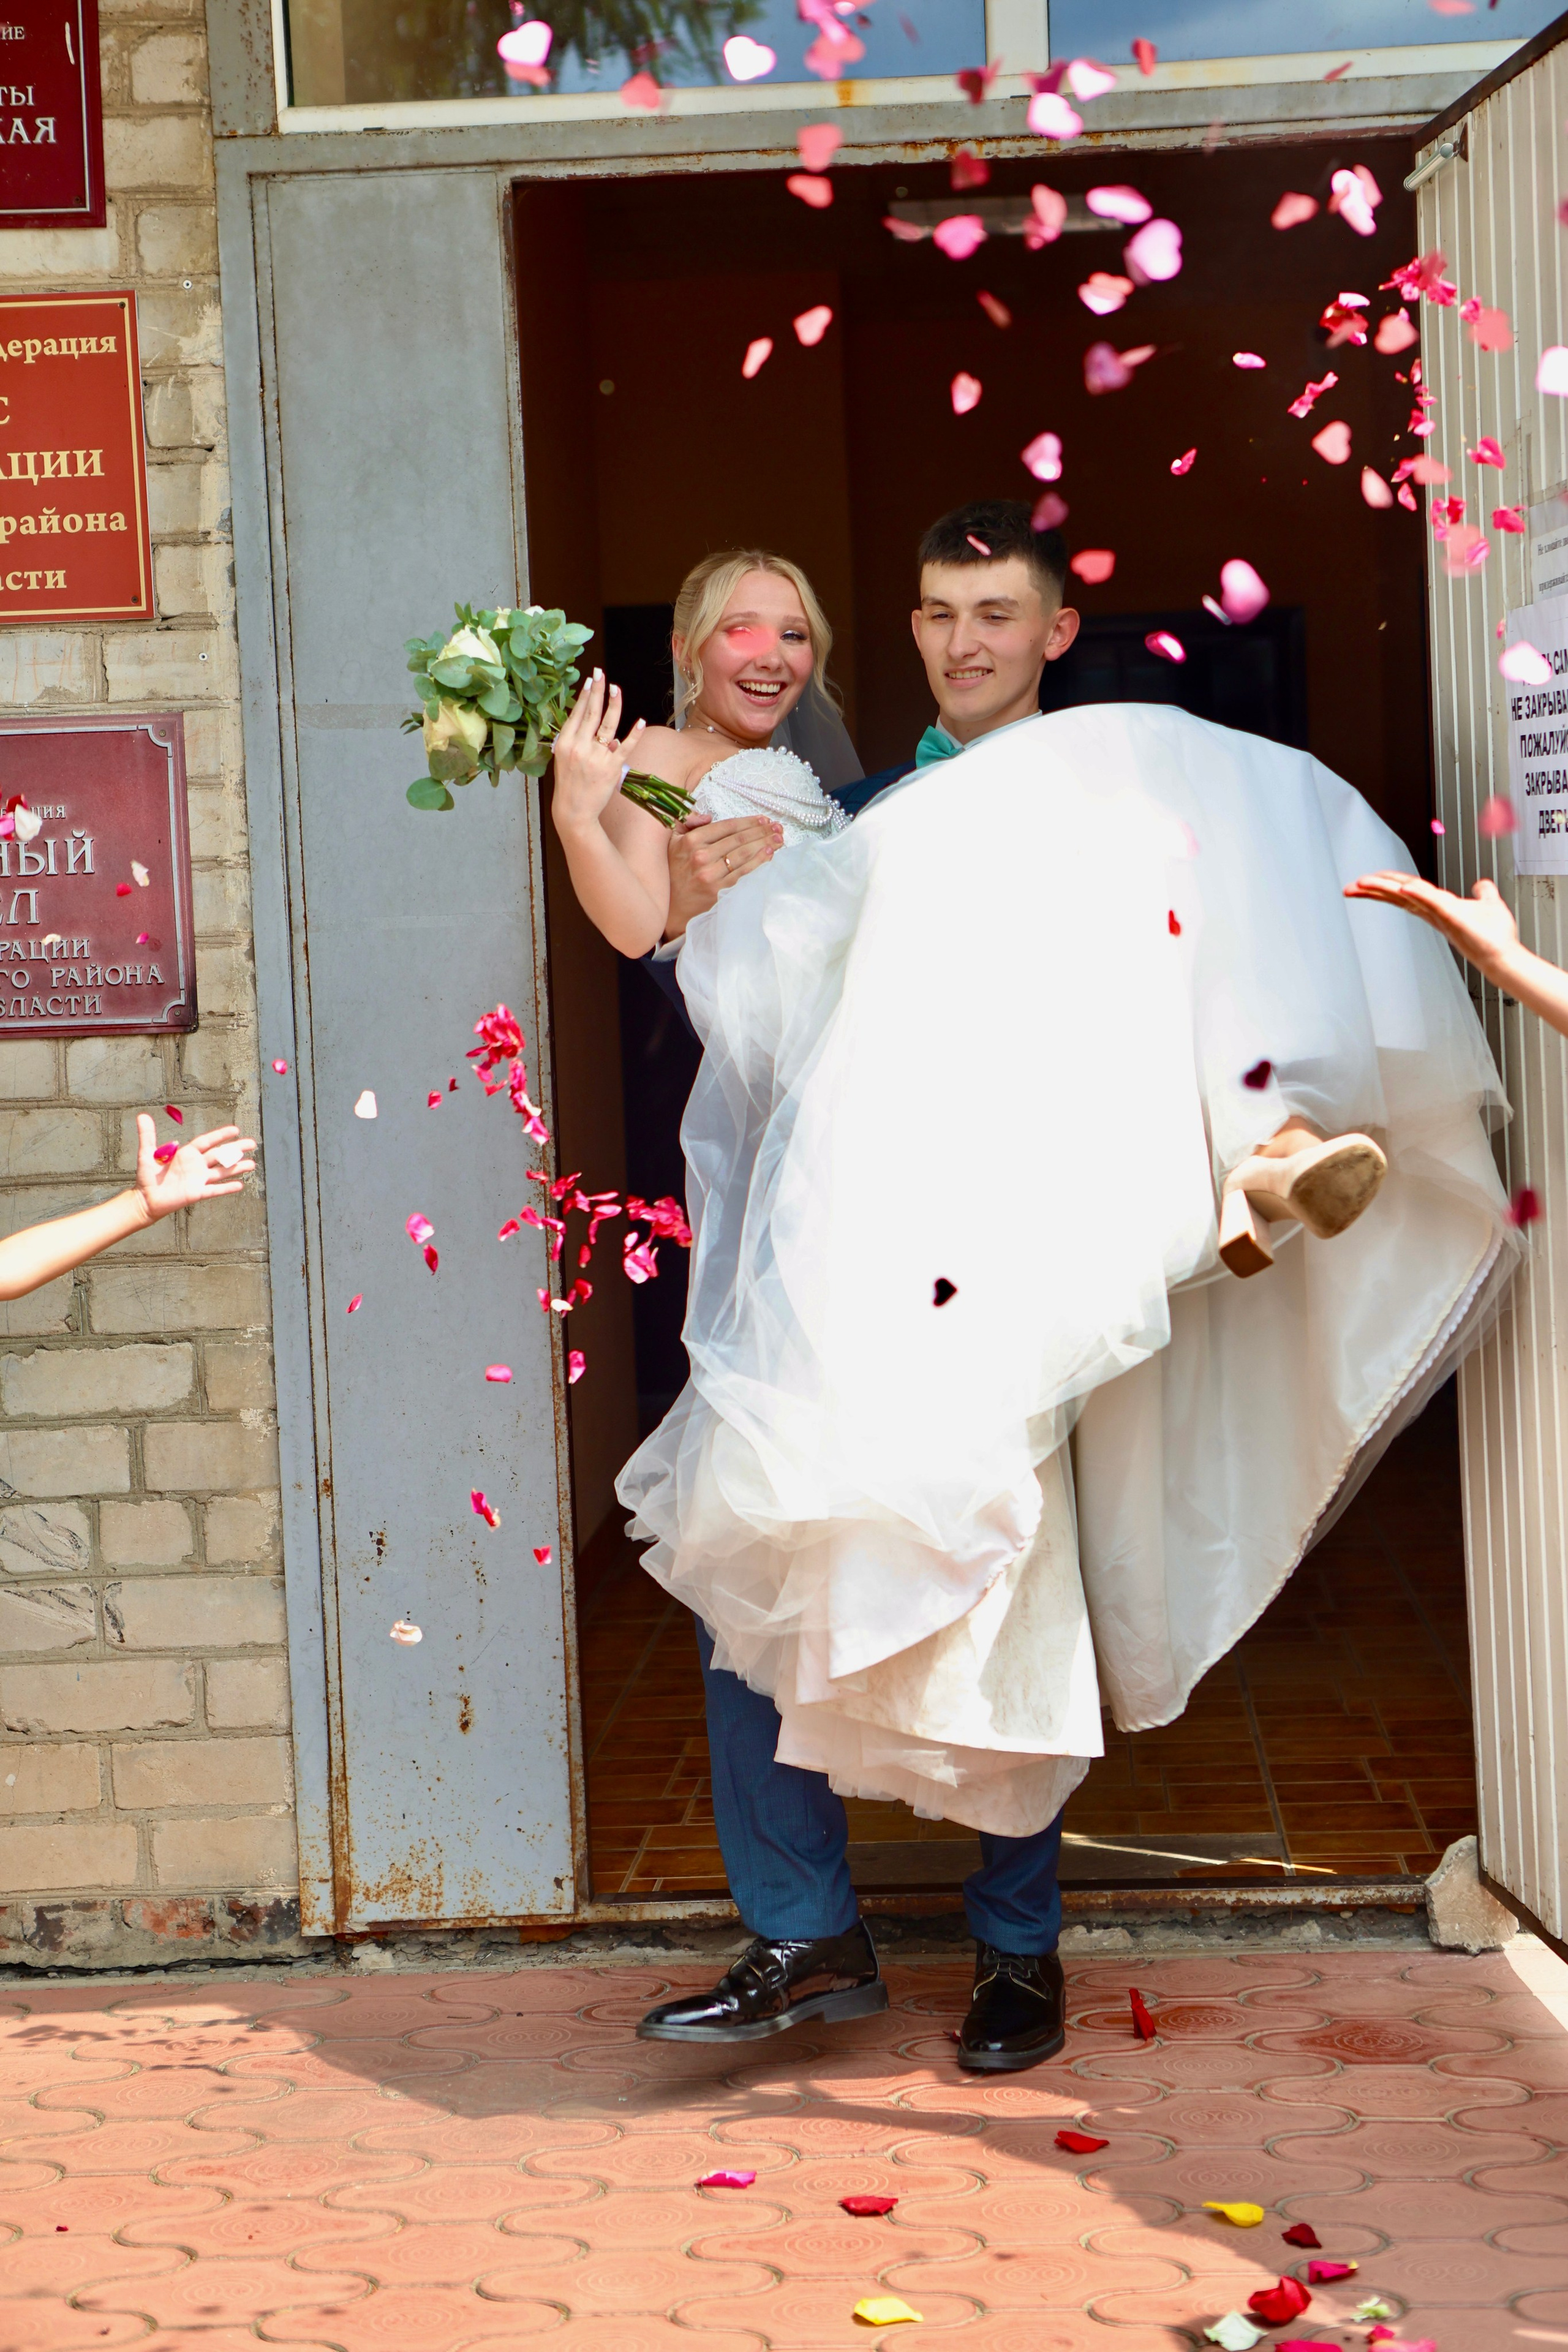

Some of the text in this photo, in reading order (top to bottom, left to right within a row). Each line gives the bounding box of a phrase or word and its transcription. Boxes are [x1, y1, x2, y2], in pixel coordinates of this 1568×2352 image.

[0, 507, 127, 544] района
[0, 570, 67, 591] сти
[1511, 689, 1568, 721] НЕ ЗАКРЫВА
[0, 890, 40, 924] Л
[51, 963, 164, 988] РАЙОНА
